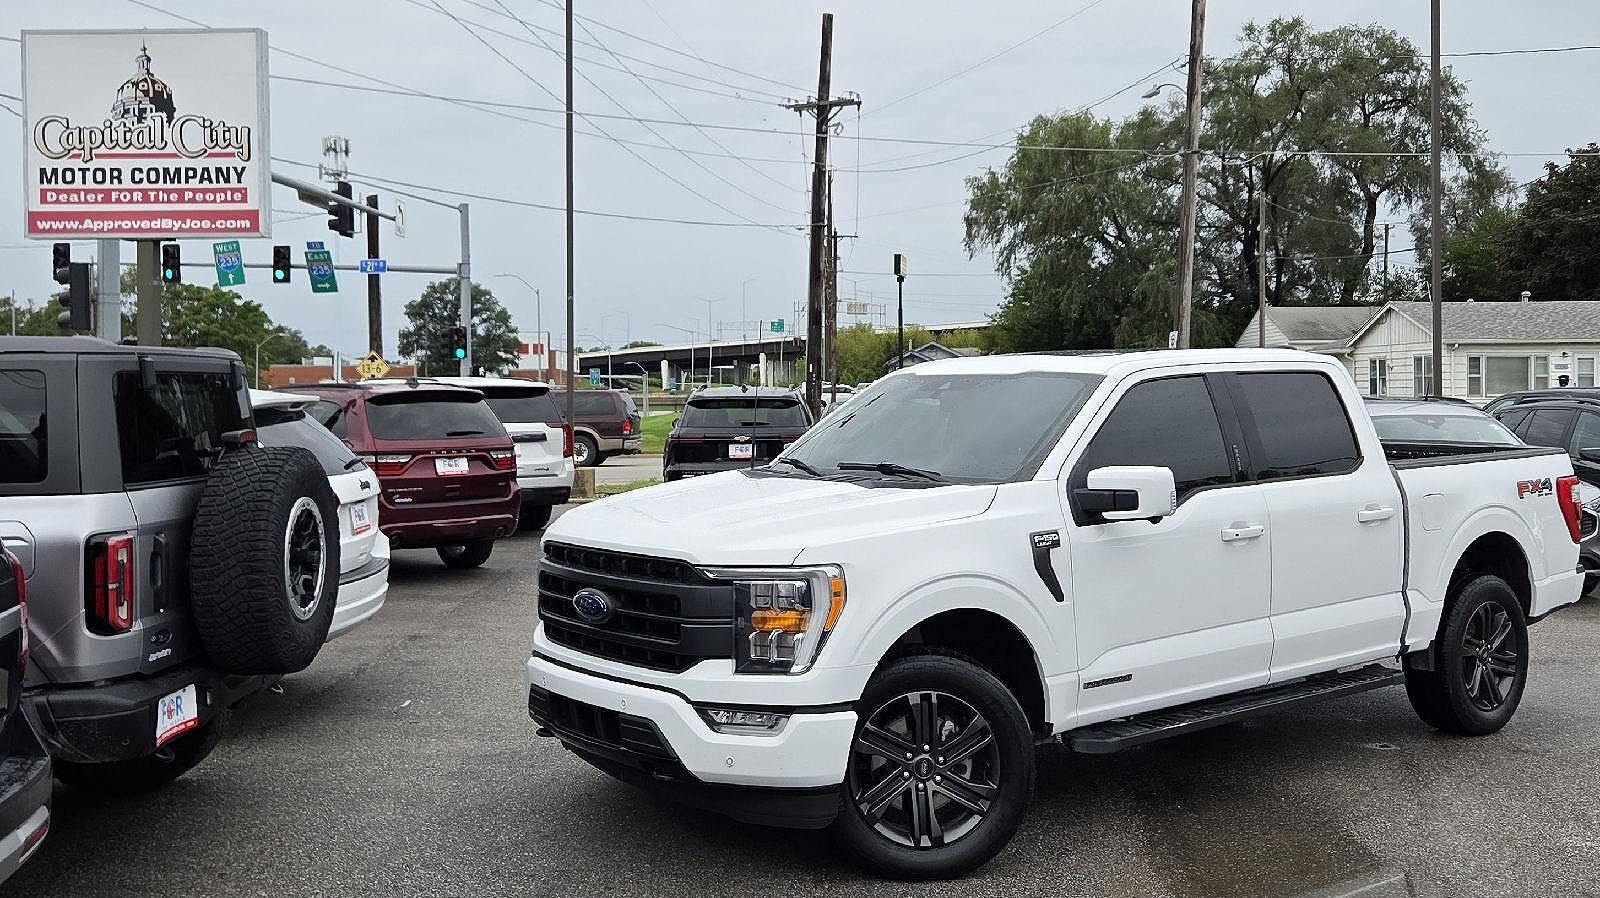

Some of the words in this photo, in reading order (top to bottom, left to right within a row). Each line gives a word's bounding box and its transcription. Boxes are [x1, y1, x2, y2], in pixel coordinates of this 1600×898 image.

[34, 114, 168, 162] Capital
[172, 114, 251, 162] City
[39, 167, 123, 185] MOTOR
[130, 166, 247, 185] COMPANY
[46, 190, 105, 203] Dealer
[111, 190, 143, 203] FOR
[148, 190, 179, 202] The
[184, 189, 242, 204] People
[36, 217, 251, 232] www.ApprovedByJoe.com
[215, 243, 237, 252] WEST
[219, 256, 239, 267] 235
[312, 264, 331, 275] 235
[1516, 477, 1553, 499] FX4
[1033, 533, 1059, 542] F-150
